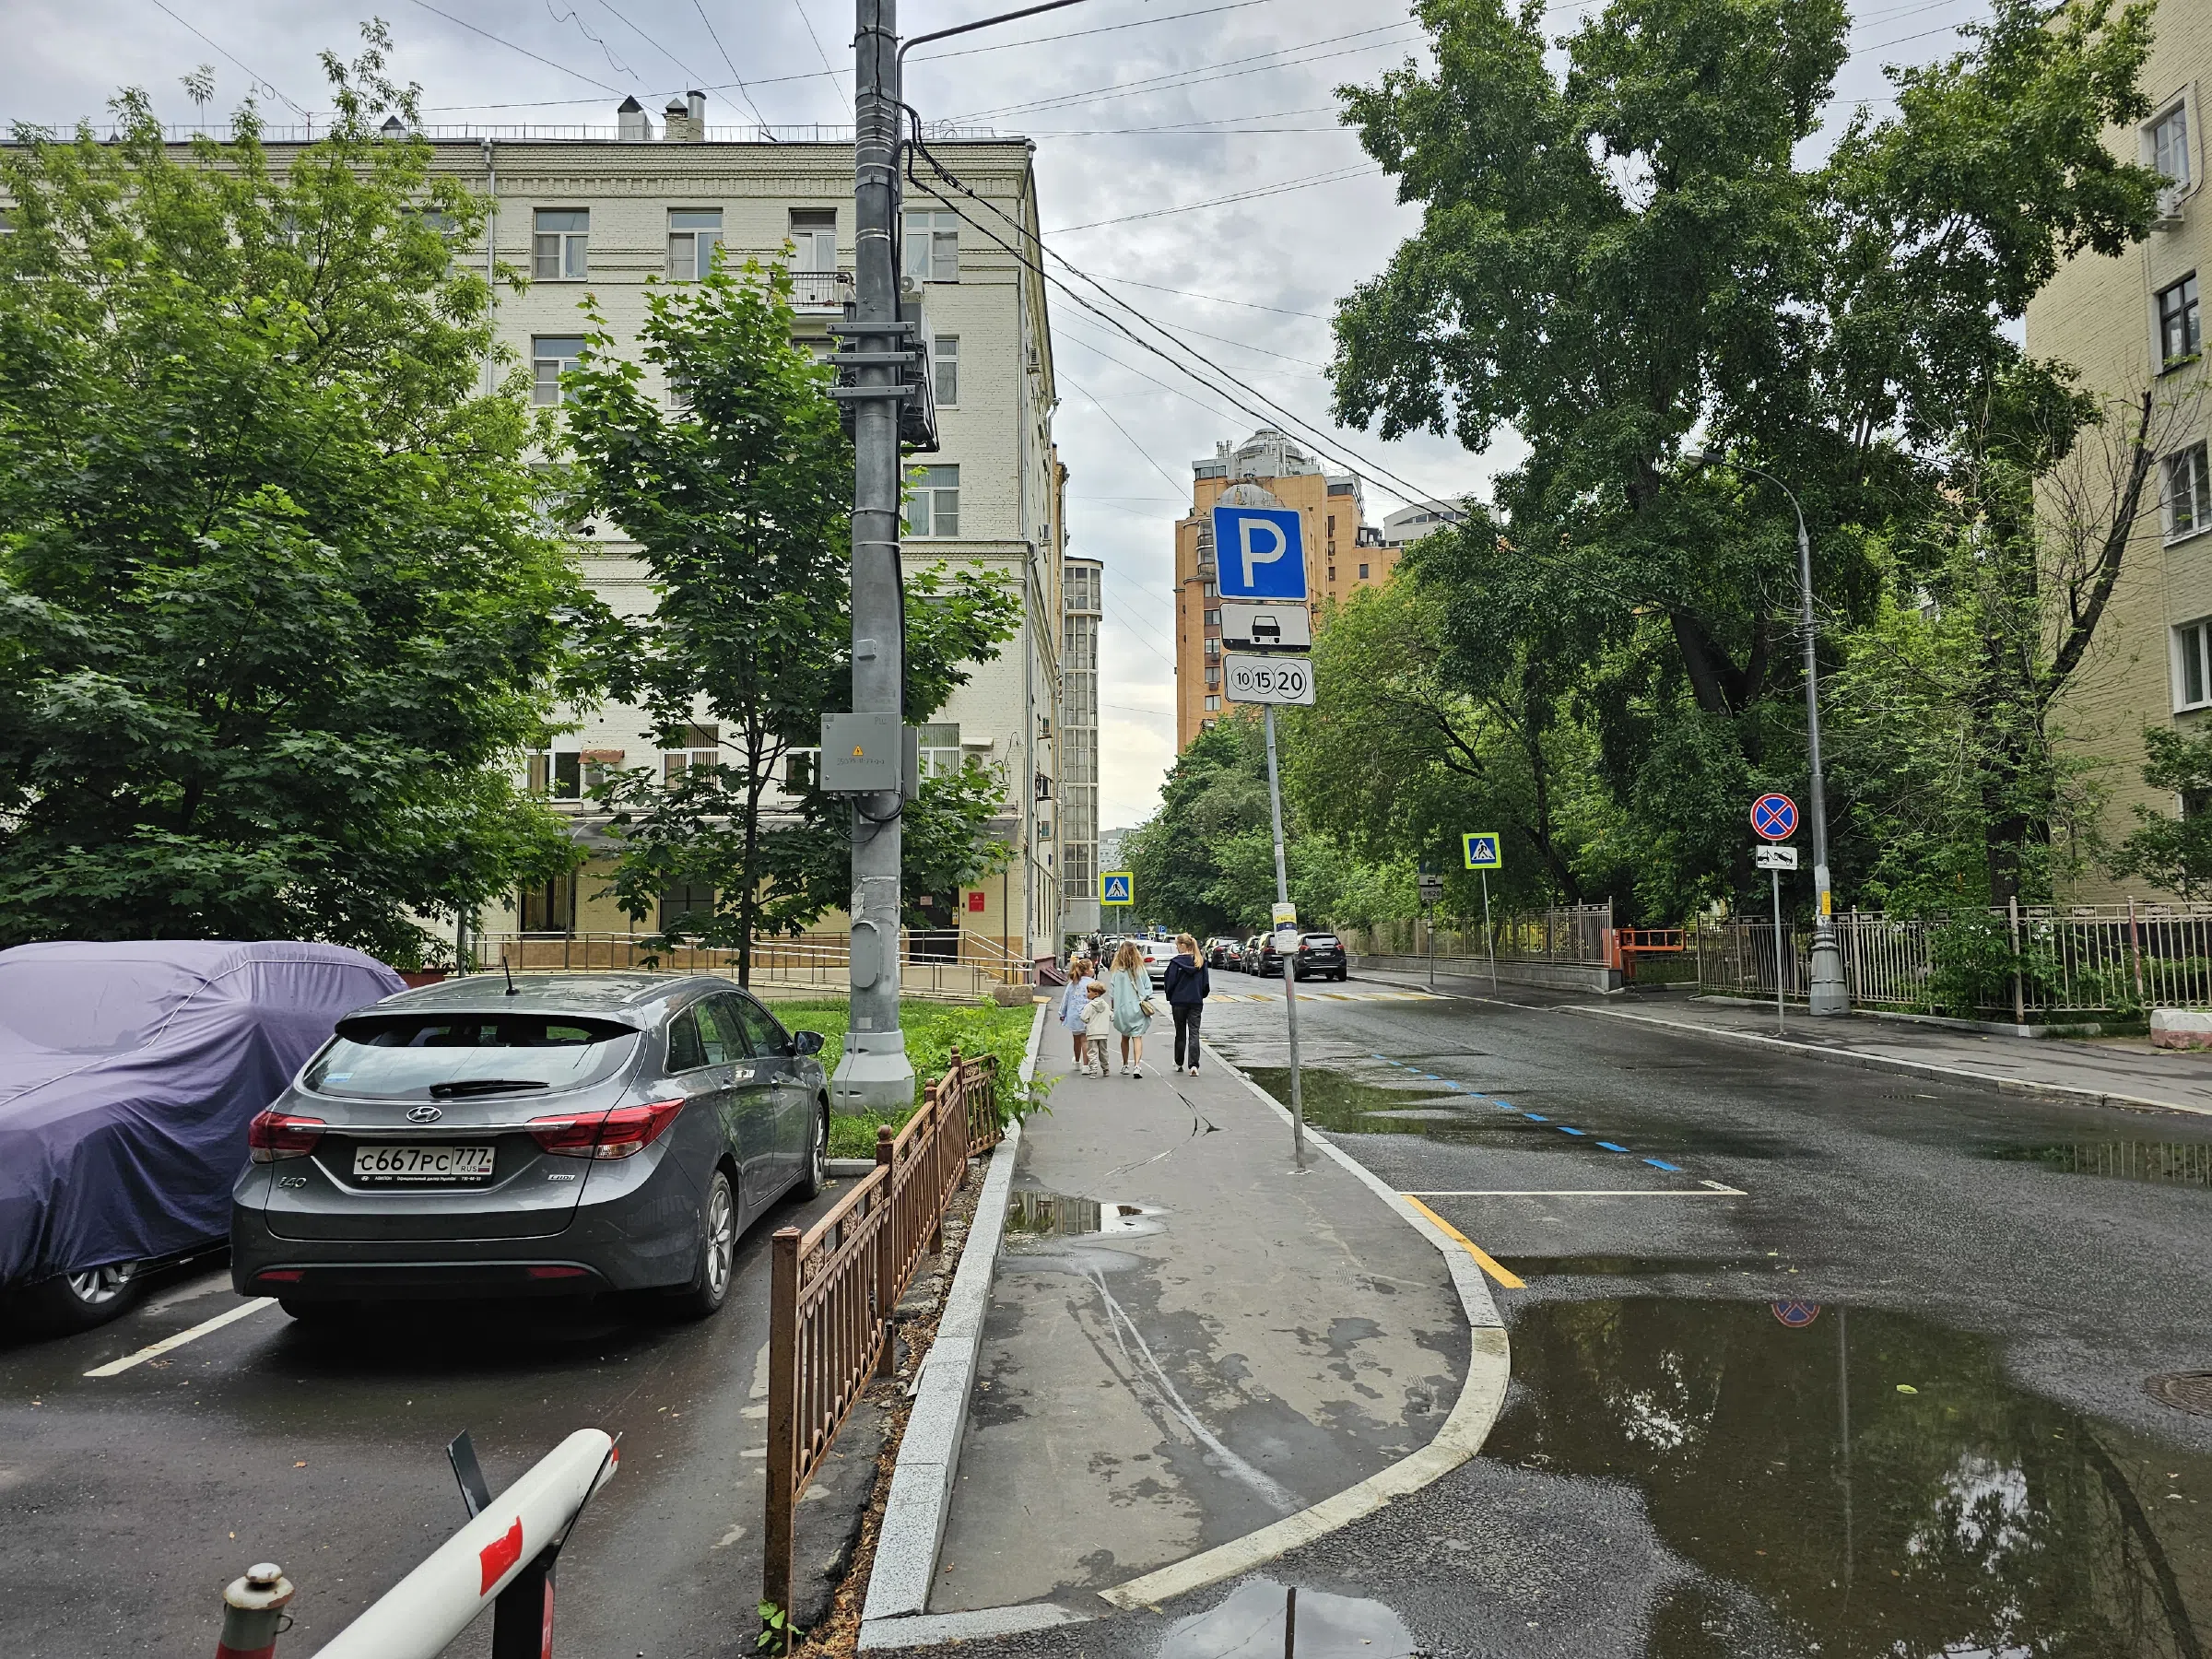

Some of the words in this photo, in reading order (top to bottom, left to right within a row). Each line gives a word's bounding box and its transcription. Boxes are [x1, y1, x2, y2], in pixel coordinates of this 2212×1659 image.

[1238, 517, 1287, 588] P
[1236, 672, 1250, 686] 10
[1254, 672, 1271, 688] 15
[1277, 672, 1303, 691] 20
[454, 1148, 489, 1166] 777
[278, 1176, 307, 1189] i40
